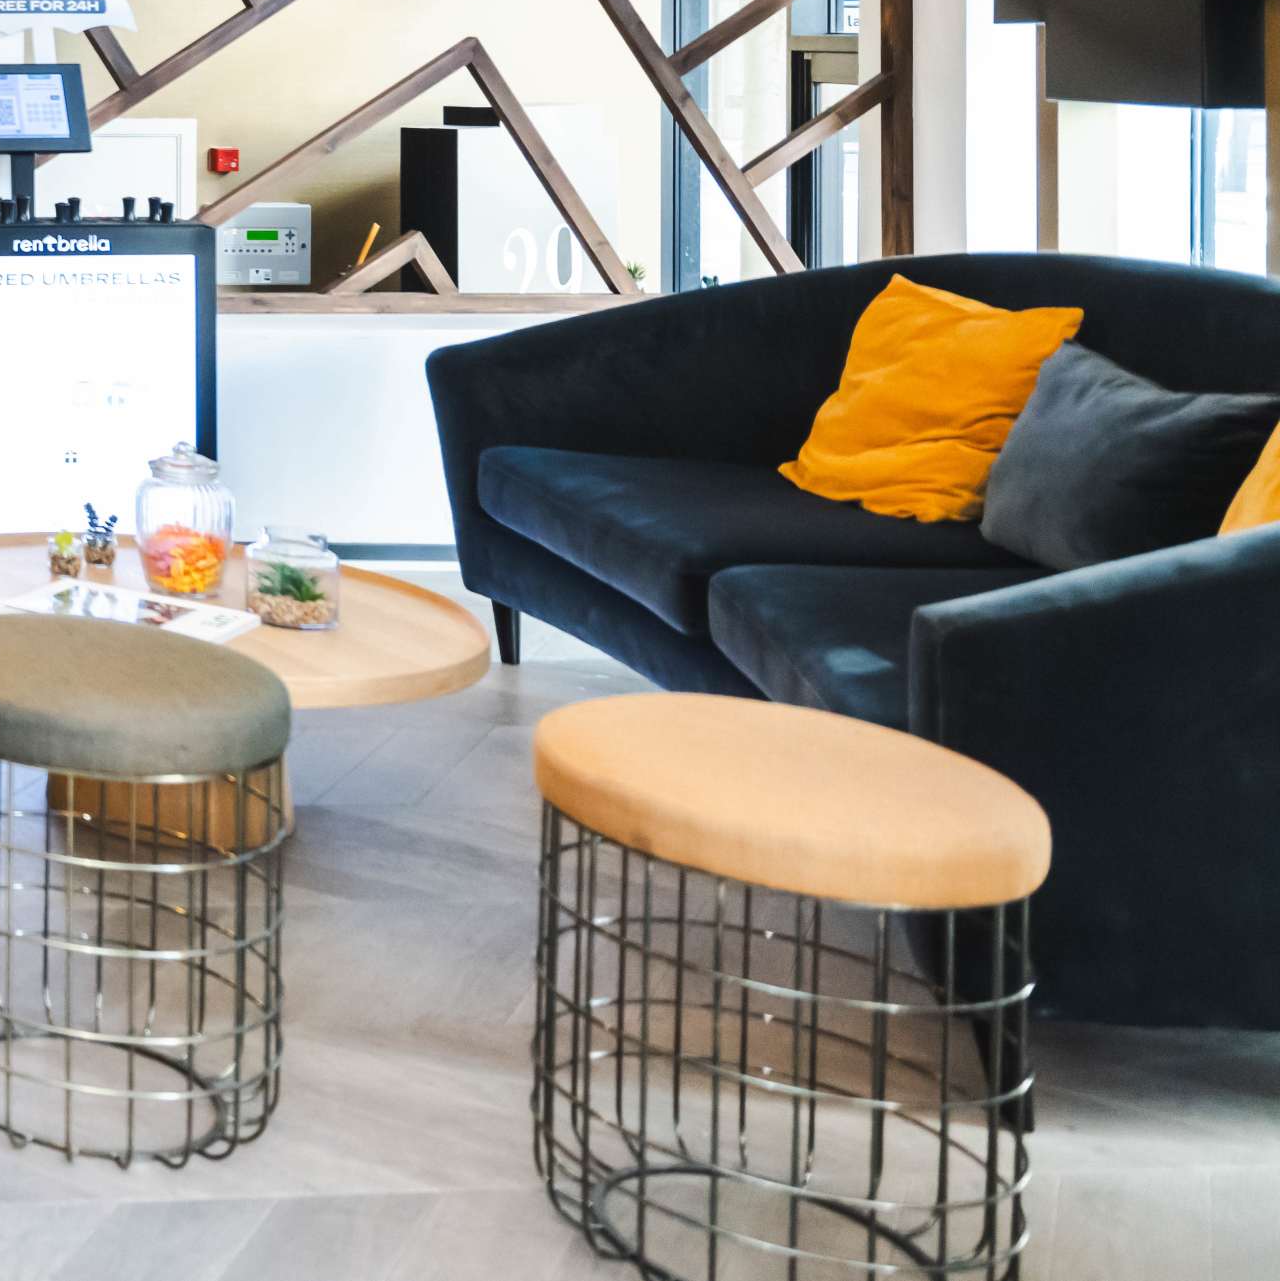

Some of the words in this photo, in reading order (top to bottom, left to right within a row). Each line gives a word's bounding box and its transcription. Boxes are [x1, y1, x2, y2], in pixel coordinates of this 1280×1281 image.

[30, 0, 65, 12] FOR
[67, 0, 100, 12] 24H
[13, 234, 111, 253] rentbrella
[42, 272, 182, 286] UMBRELLAS
